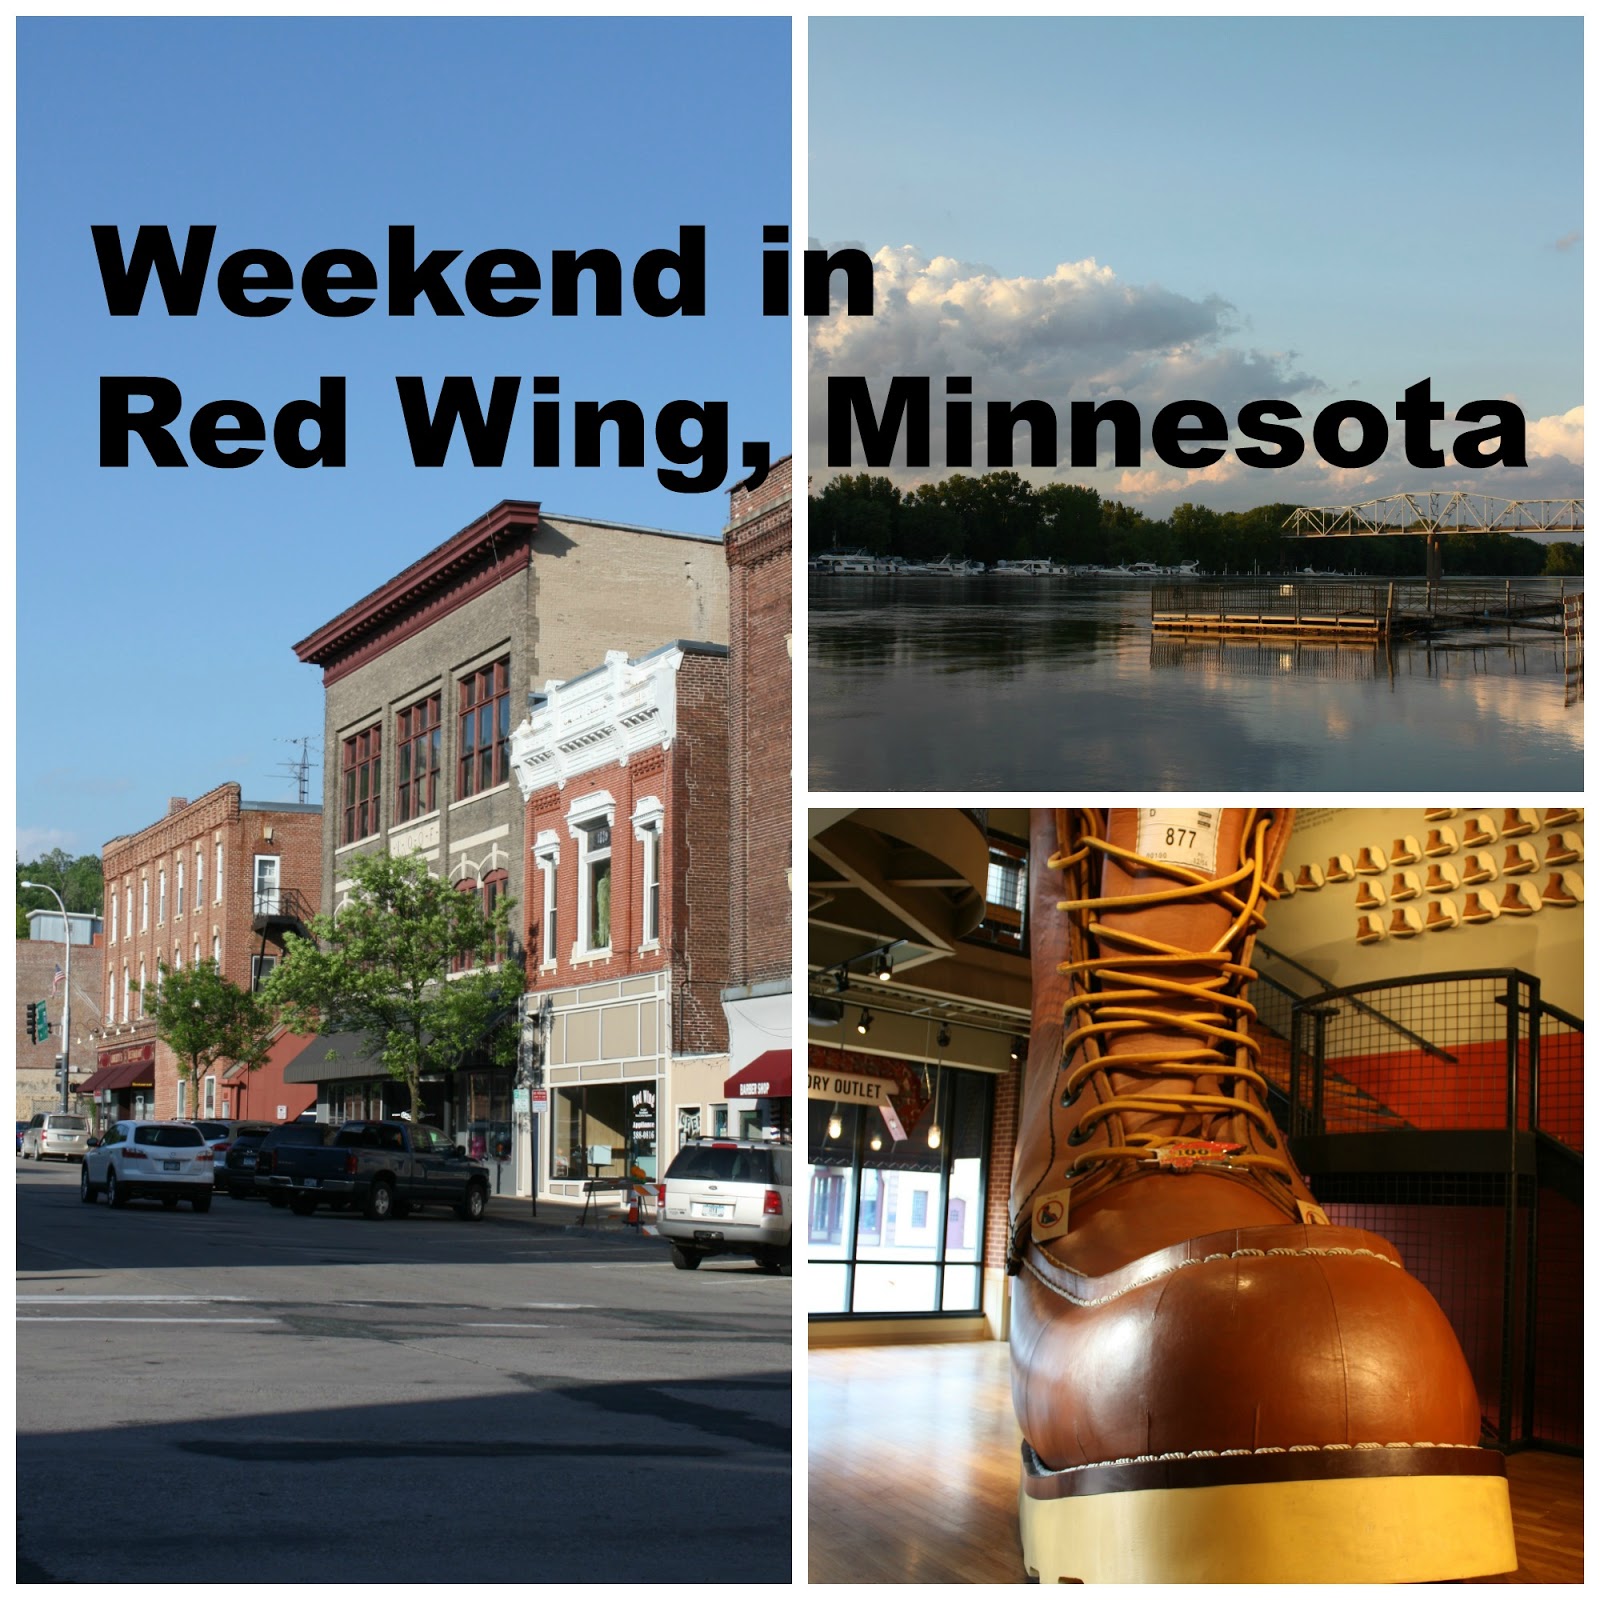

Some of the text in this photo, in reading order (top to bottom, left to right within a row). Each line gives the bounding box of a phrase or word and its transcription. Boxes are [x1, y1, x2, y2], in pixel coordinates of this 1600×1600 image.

[1165, 827, 1197, 849] 877
[740, 1082, 770, 1096] BARBER SHOP
[834, 1078, 882, 1099] OUTLET
[680, 1113, 700, 1131] OPE
